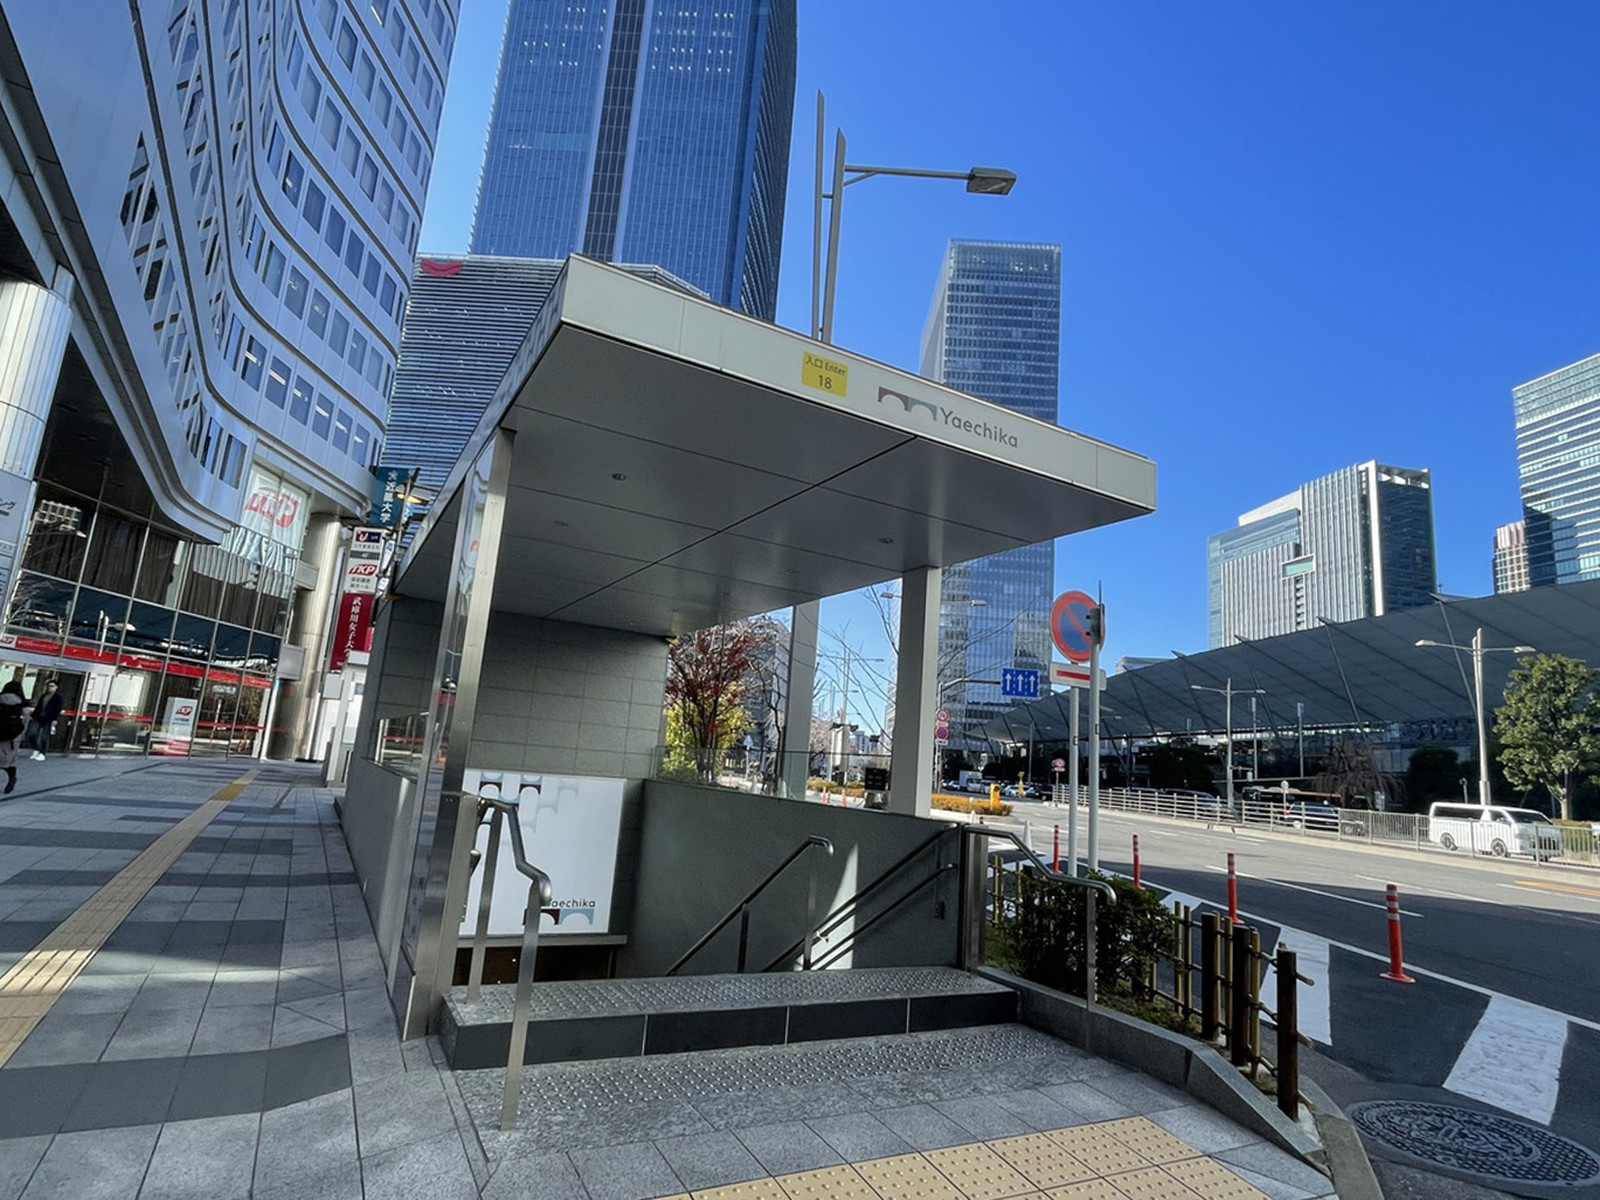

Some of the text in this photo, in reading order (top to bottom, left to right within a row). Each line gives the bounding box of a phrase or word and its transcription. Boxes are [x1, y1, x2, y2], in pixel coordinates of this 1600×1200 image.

[805, 354, 846, 377] 入口 Enter
[817, 374, 833, 390] 18
[939, 406, 1019, 448] Yaechika
[350, 565, 377, 576] TKP
[549, 898, 596, 908] aechika
